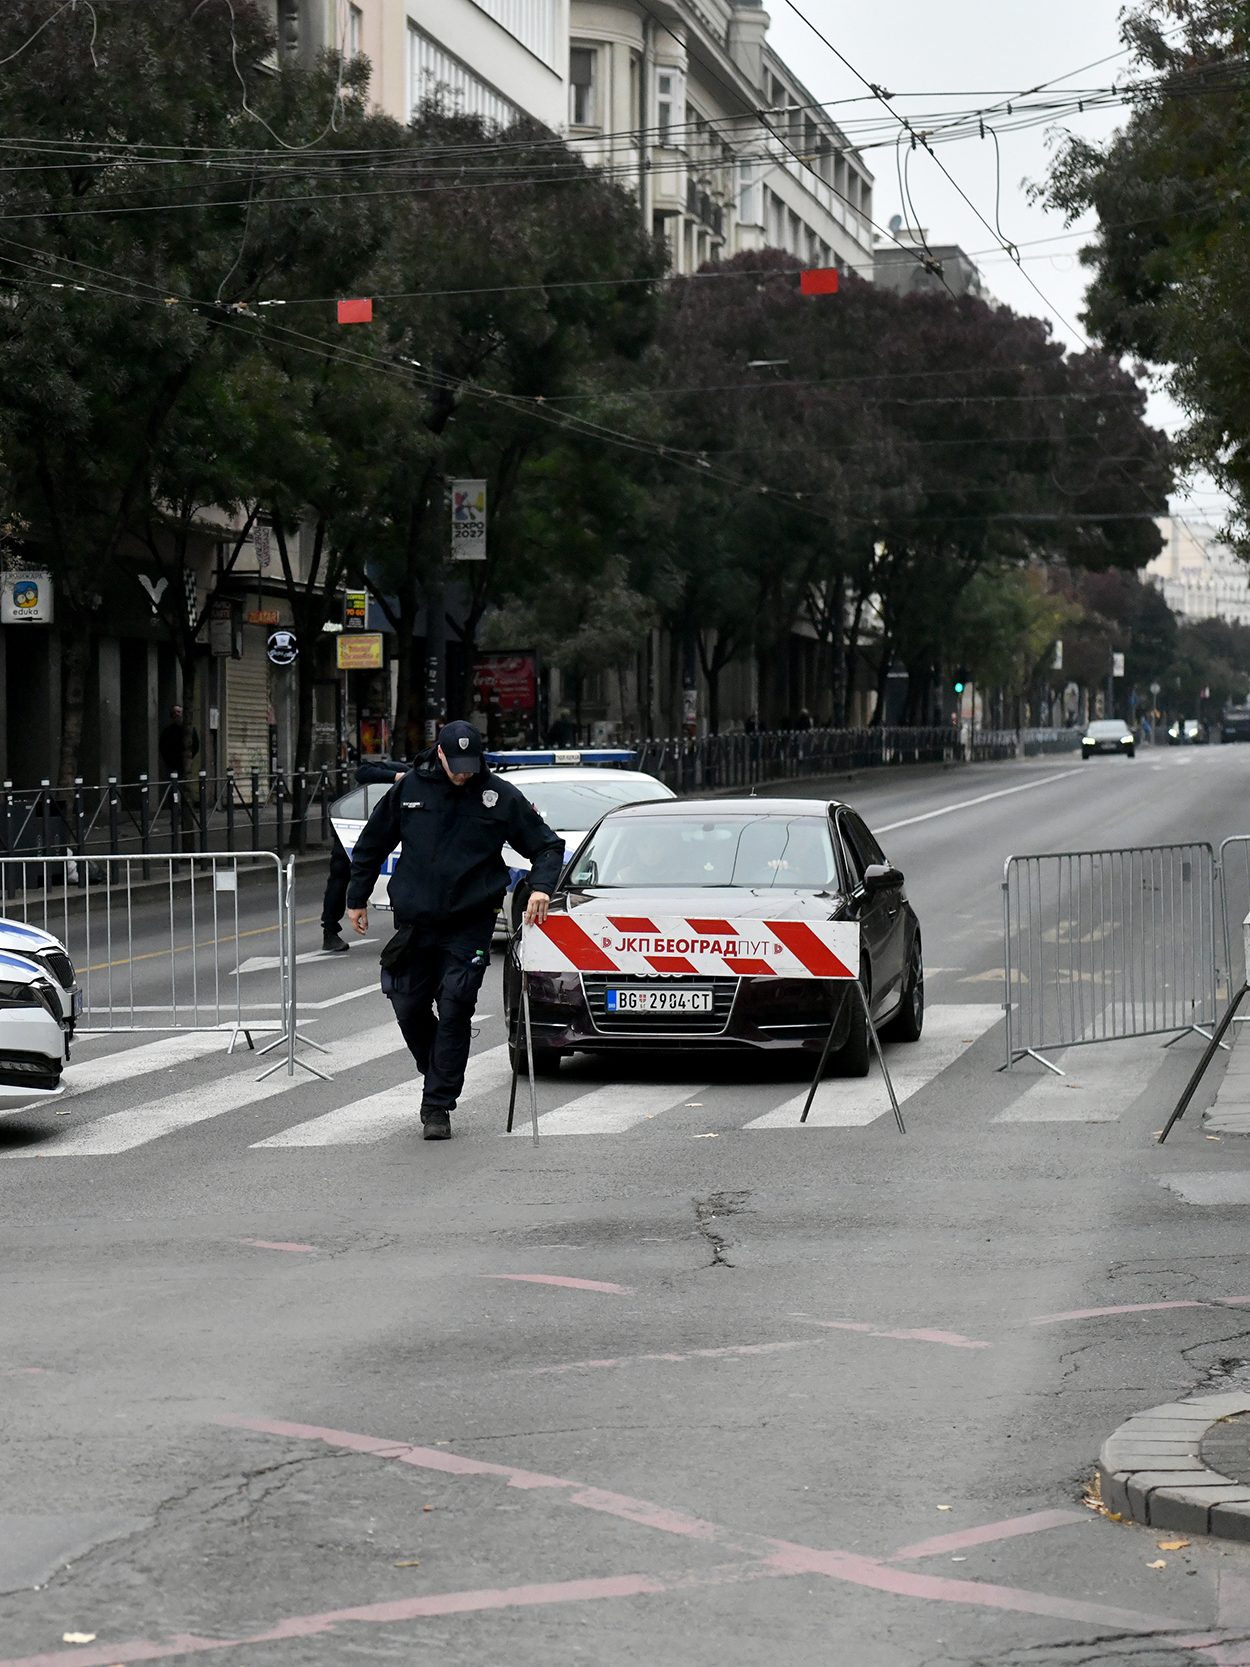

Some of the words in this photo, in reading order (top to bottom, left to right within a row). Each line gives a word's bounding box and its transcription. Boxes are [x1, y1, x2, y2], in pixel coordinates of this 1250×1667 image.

[455, 522, 484, 530] EXPO
[455, 530, 484, 538] 2027
[13, 608, 38, 616] eduka
[614, 938, 650, 952] ЈКП
[619, 992, 637, 1009] BG
